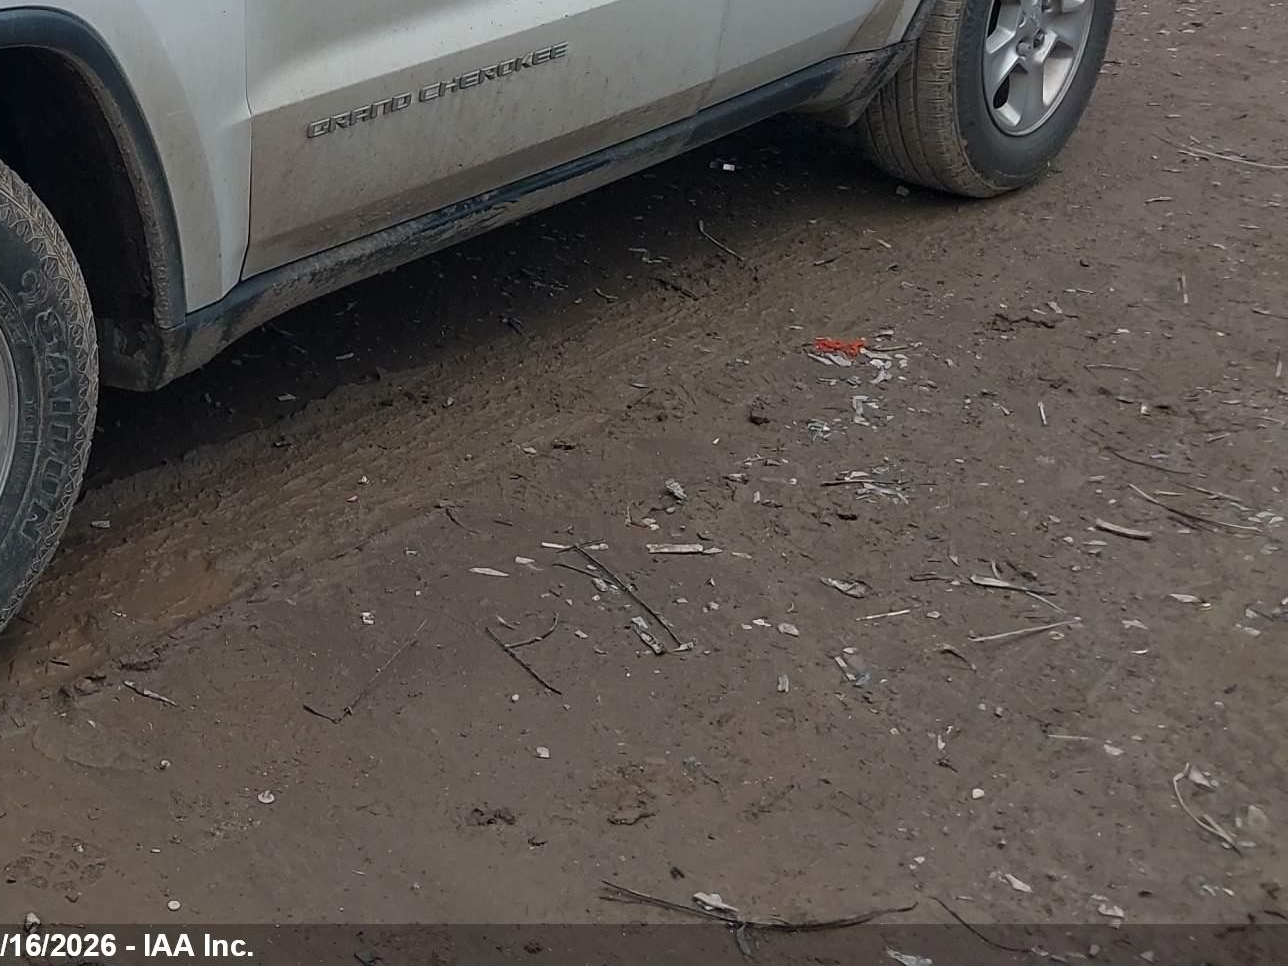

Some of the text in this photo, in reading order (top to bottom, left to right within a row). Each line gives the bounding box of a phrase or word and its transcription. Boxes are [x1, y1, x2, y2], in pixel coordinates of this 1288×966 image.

[307, 41, 569, 139] GRAND CHEROKEE
[21, 307, 73, 544] SAILUN
